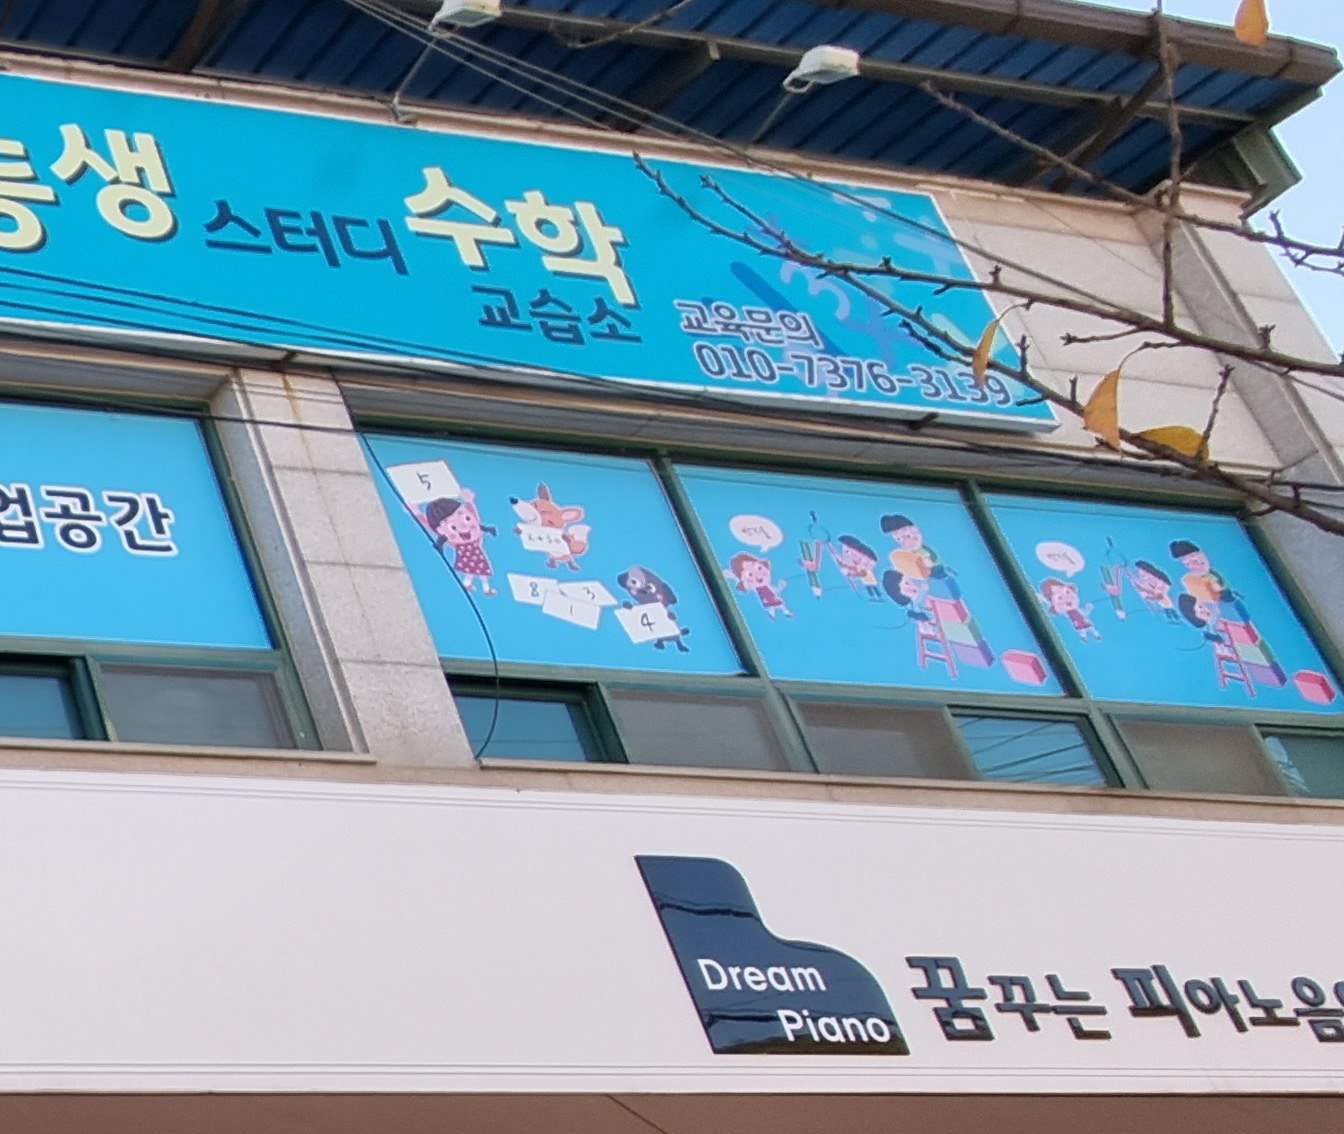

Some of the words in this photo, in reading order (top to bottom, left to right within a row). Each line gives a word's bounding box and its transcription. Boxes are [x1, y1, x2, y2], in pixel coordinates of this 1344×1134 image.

[205, 202, 406, 276] 스터디
[404, 154, 637, 306] 수학
[478, 285, 641, 343] 교습소
[674, 300, 824, 348] 교육문의
[694, 342, 1011, 407] 010-7376-3139
[697, 958, 827, 993] Dream
[905, 956, 1112, 1043] 꿈꾸는
[1110, 964, 1344, 1043] 피아노음
[780, 1009, 891, 1044] Piano
